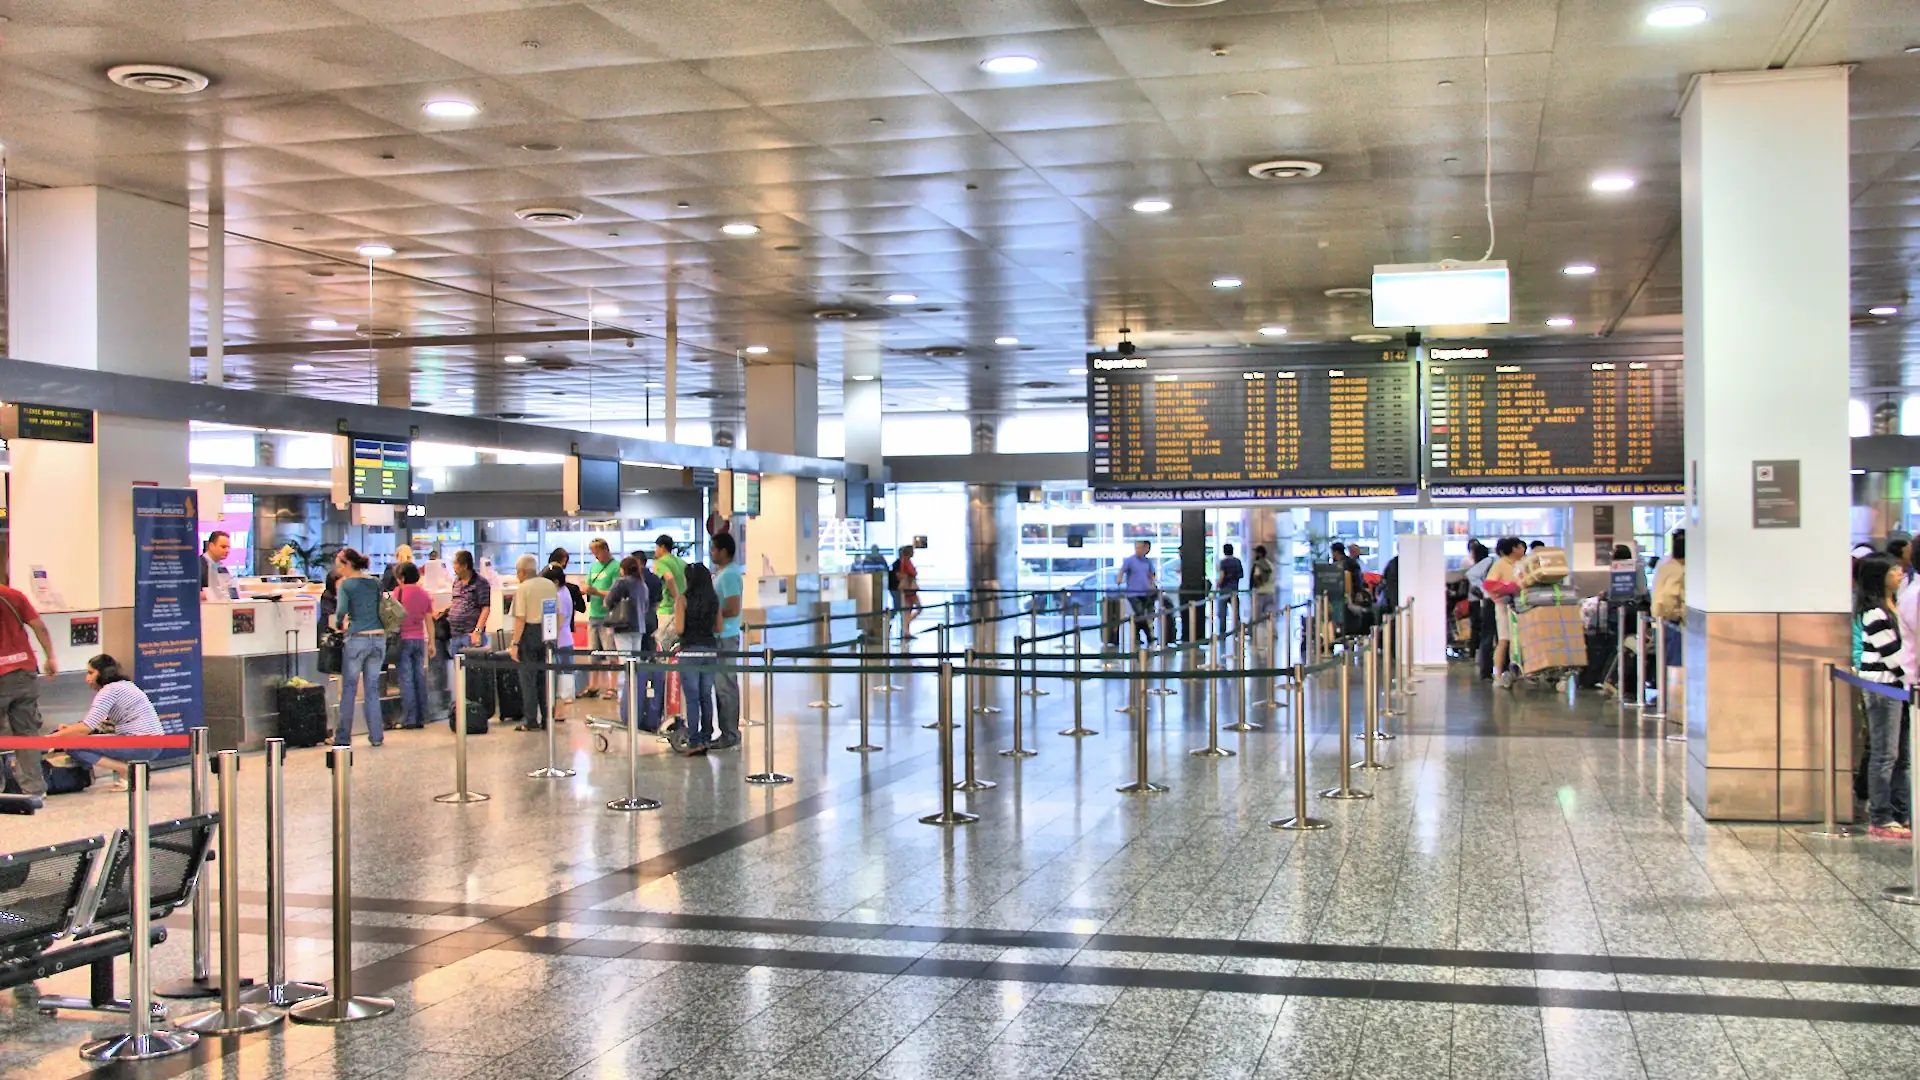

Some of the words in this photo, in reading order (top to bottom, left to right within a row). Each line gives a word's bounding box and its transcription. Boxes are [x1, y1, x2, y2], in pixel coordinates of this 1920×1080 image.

[1096, 491, 1130, 500] LIQUIDS,
[1131, 490, 1173, 499] AEROSOLS
[1175, 490, 1181, 499] &
[1183, 490, 1202, 499] GELS
[1203, 490, 1226, 499] OVER
[1257, 489, 1272, 497] PUT
[1274, 489, 1281, 497] IT
[1284, 488, 1292, 497] IN
[1295, 488, 1318, 497] YOUR
[1320, 488, 1346, 496] CHECK
[1349, 488, 1357, 496] IN
[1360, 488, 1398, 496] LUGGAGE.
[1432, 487, 1467, 496] LIQUIDS,
[1470, 487, 1514, 495] AEROSOLS
[1517, 487, 1523, 495] &
[1526, 486, 1546, 495] GELS
[1548, 486, 1572, 494] OVER
[1606, 485, 1622, 493] PUT
[1624, 485, 1632, 493] IT
[1634, 485, 1644, 493] IN
[1647, 485, 1673, 493] YOUR
